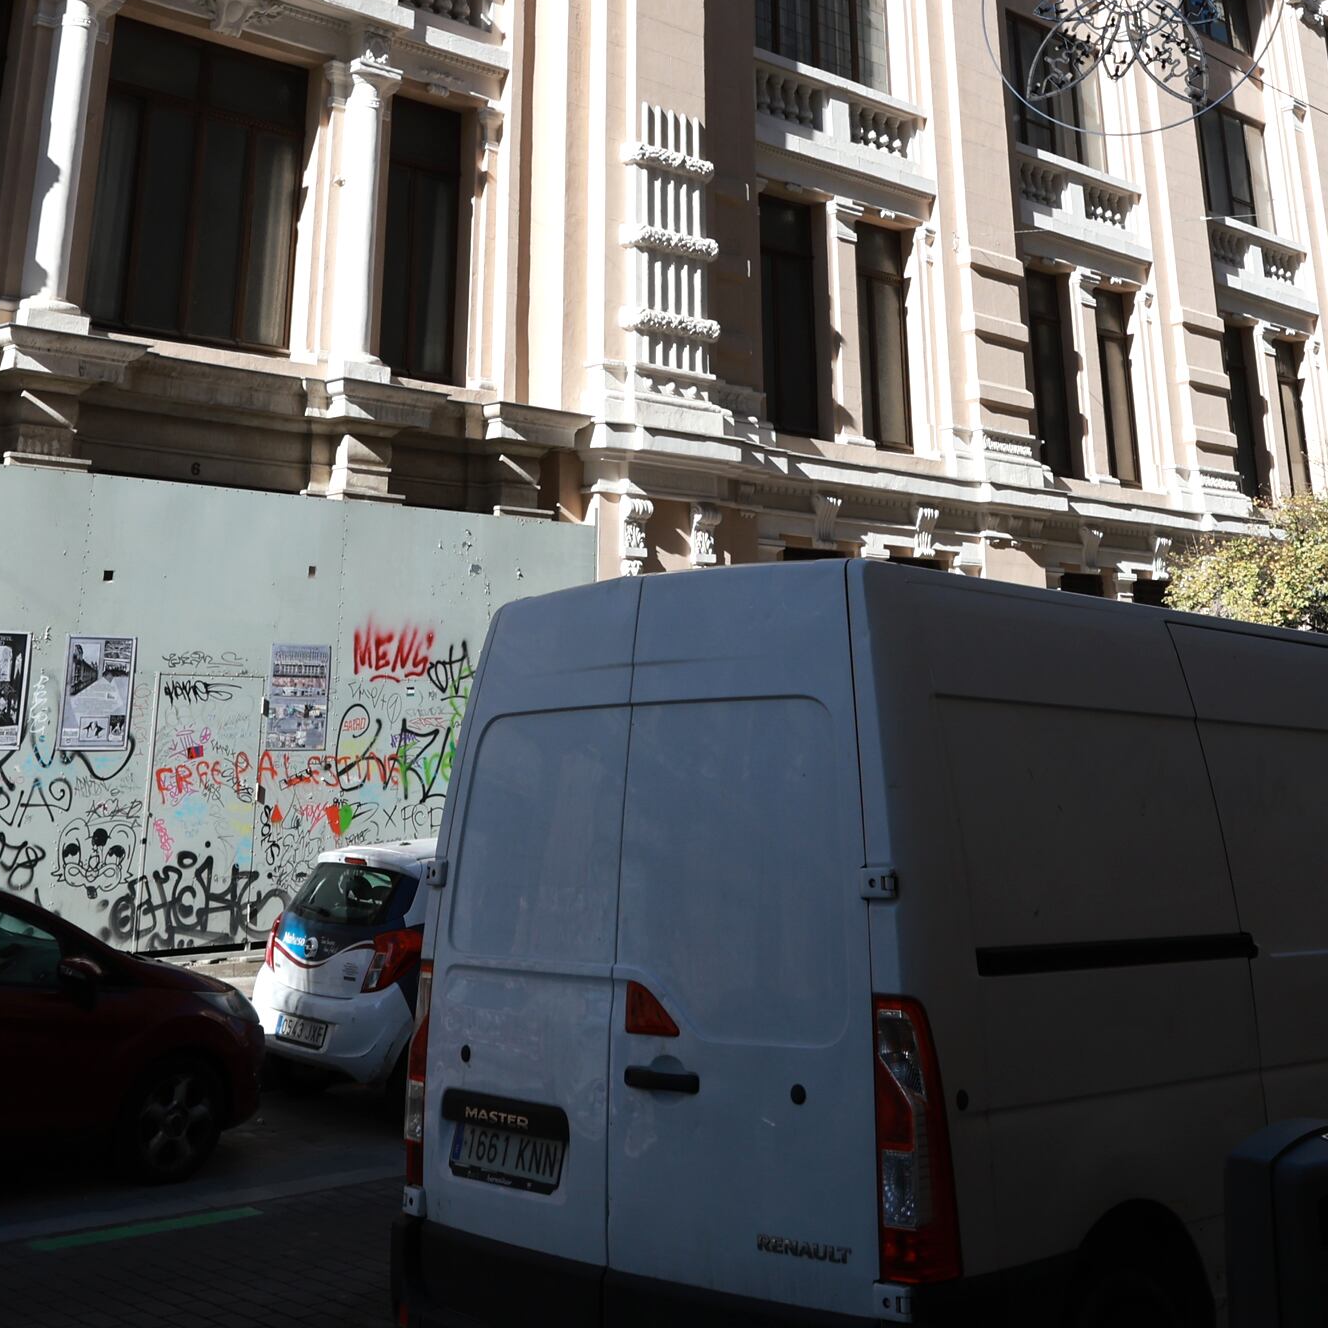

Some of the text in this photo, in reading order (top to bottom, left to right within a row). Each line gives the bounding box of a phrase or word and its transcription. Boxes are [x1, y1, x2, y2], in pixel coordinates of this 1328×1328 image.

[465, 1106, 529, 1128] MASTER
[467, 1127, 557, 1178] 1661 KNN
[757, 1234, 852, 1265] RENAULT
